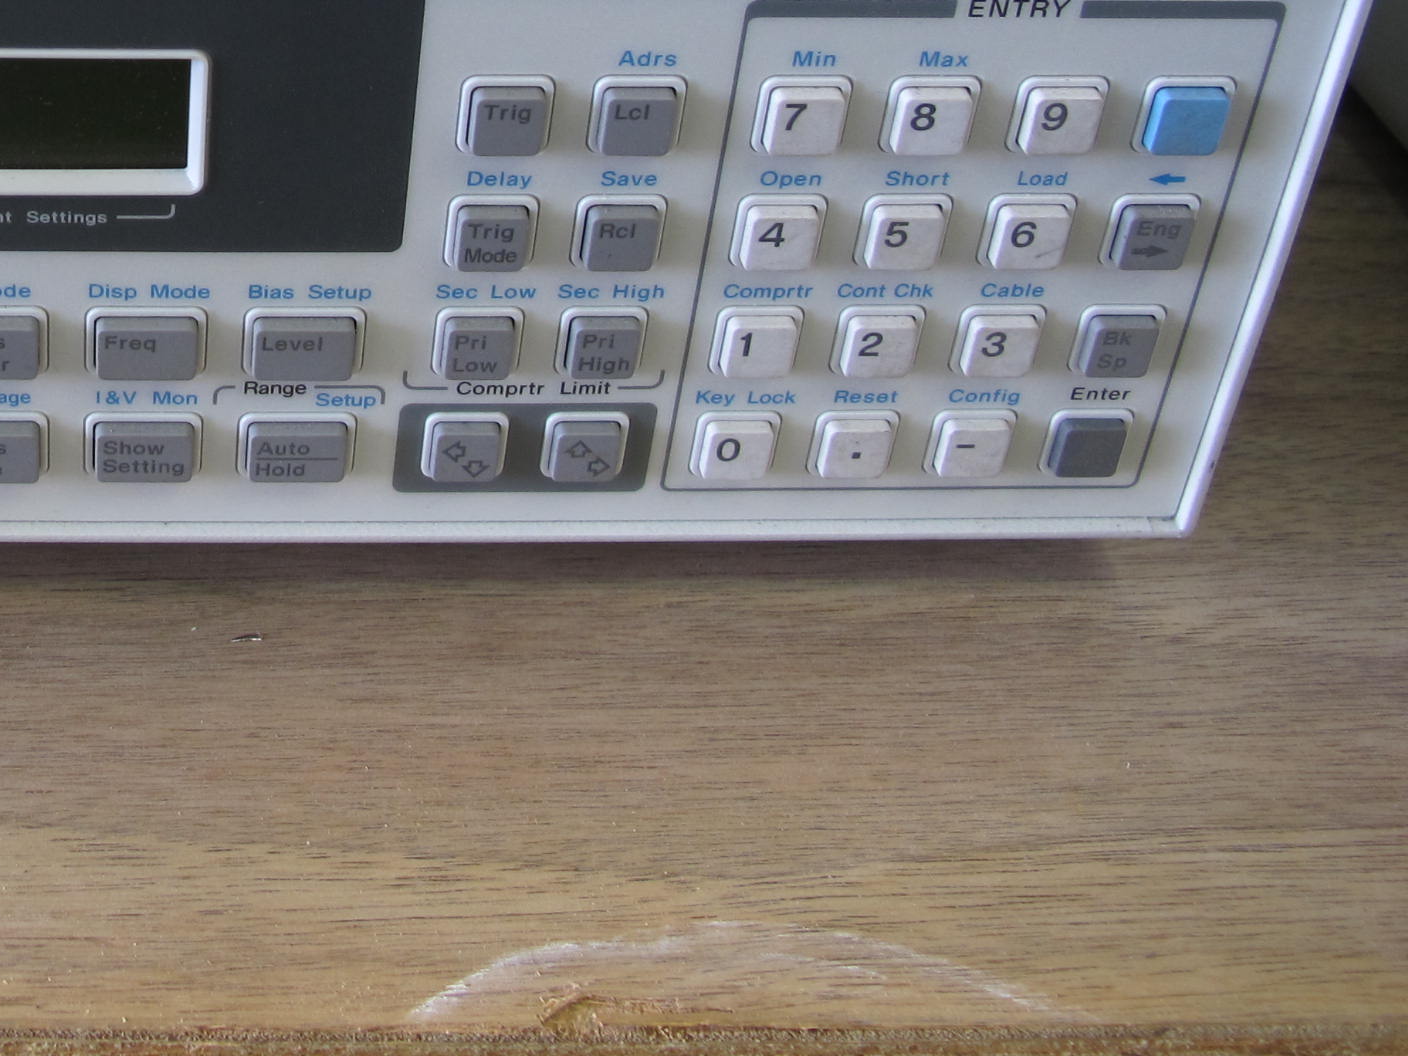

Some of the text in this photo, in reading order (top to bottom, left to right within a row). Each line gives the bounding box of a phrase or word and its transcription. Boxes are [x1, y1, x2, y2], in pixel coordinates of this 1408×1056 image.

[617, 50, 678, 67] Adrs
[792, 51, 837, 68] Min
[918, 51, 969, 69] Max
[484, 104, 532, 124] Trig
[614, 103, 650, 121] Lcl
[783, 102, 808, 132] 7
[909, 102, 938, 132] 8
[1039, 102, 1069, 132] 9
[466, 170, 533, 189] Delay
[600, 171, 658, 187] Save
[759, 170, 823, 190] Open
[884, 170, 951, 187] Short
[1017, 170, 1069, 187] Load
[26, 210, 108, 226] Settings
[466, 224, 515, 244] Trig
[598, 223, 636, 239] Rcl
[757, 221, 786, 249] 4
[883, 221, 910, 249] 5
[1009, 221, 1038, 249] 6
[1134, 220, 1182, 240] Eng
[463, 248, 517, 264] Mode
[88, 283, 211, 300] Disp Mode
[248, 284, 372, 302] Bias Setup
[435, 284, 537, 300] Sec Low
[558, 284, 665, 302] Sec High
[723, 283, 814, 300] Comprtr
[837, 282, 934, 298] Cont Chk
[980, 282, 1045, 299] Cable
[104, 335, 157, 353] Freq
[261, 335, 324, 352] Level
[454, 334, 487, 351] Pri
[582, 333, 615, 350] Pri
[739, 331, 754, 357] 1
[857, 331, 885, 358] 2
[980, 331, 1008, 358] 3
[1102, 330, 1132, 347] Bk
[452, 356, 498, 373] Low
[578, 355, 630, 375] High
[1096, 352, 1127, 372] Sp
[152, 390, 198, 406] Mon
[243, 380, 307, 398] Range
[455, 380, 612, 398] Comprtr Limit
[695, 389, 797, 407] Key Lock
[833, 389, 899, 405] Reset
[947, 388, 1022, 408] Config
[1069, 386, 1132, 402] Enter
[315, 392, 377, 409] Setup
[102, 440, 165, 456] Show
[256, 440, 310, 457] Auto
[715, 437, 742, 463] 0
[102, 459, 185, 477] Setting
[255, 461, 306, 478] Hold
